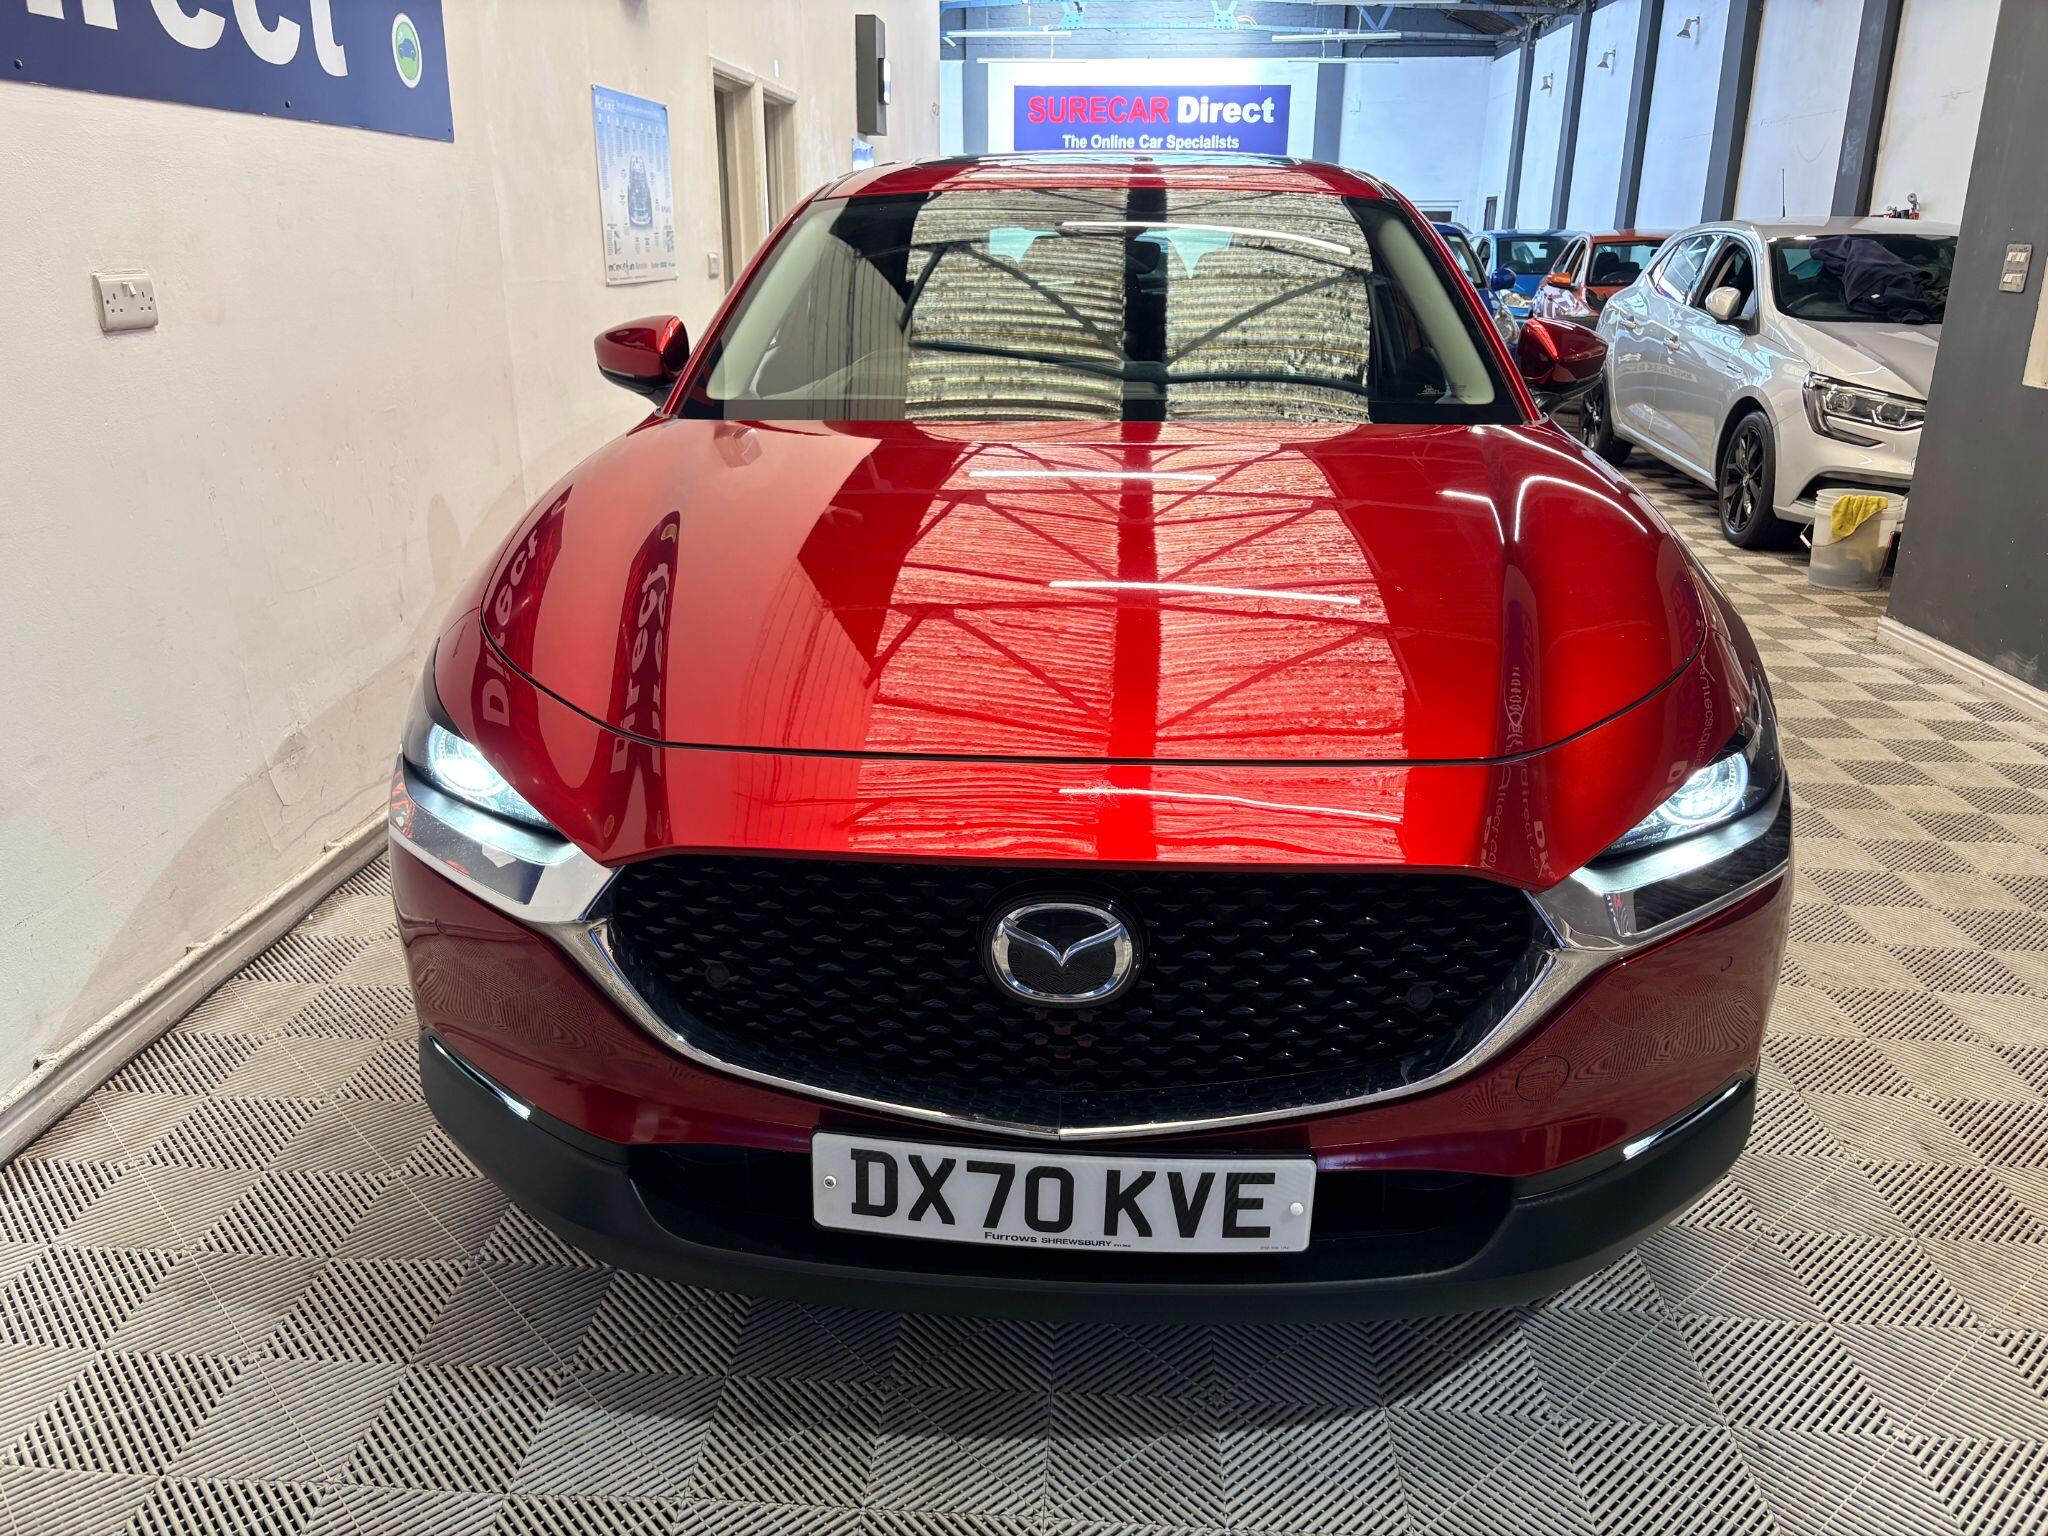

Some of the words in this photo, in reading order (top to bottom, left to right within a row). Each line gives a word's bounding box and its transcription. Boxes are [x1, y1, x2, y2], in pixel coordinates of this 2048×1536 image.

[1028, 96, 1171, 123] SURECAR
[1177, 96, 1275, 123] Direct
[1062, 134, 1088, 149] The
[1090, 134, 1135, 149] Online
[1139, 134, 1163, 149] Car
[1166, 134, 1240, 151] Specialists
[850, 1147, 1075, 1233] DX70
[1104, 1169, 1276, 1238] KVE
[985, 1231, 1038, 1243] Furrows
[1040, 1237, 1112, 1247] SHREWSBURY
